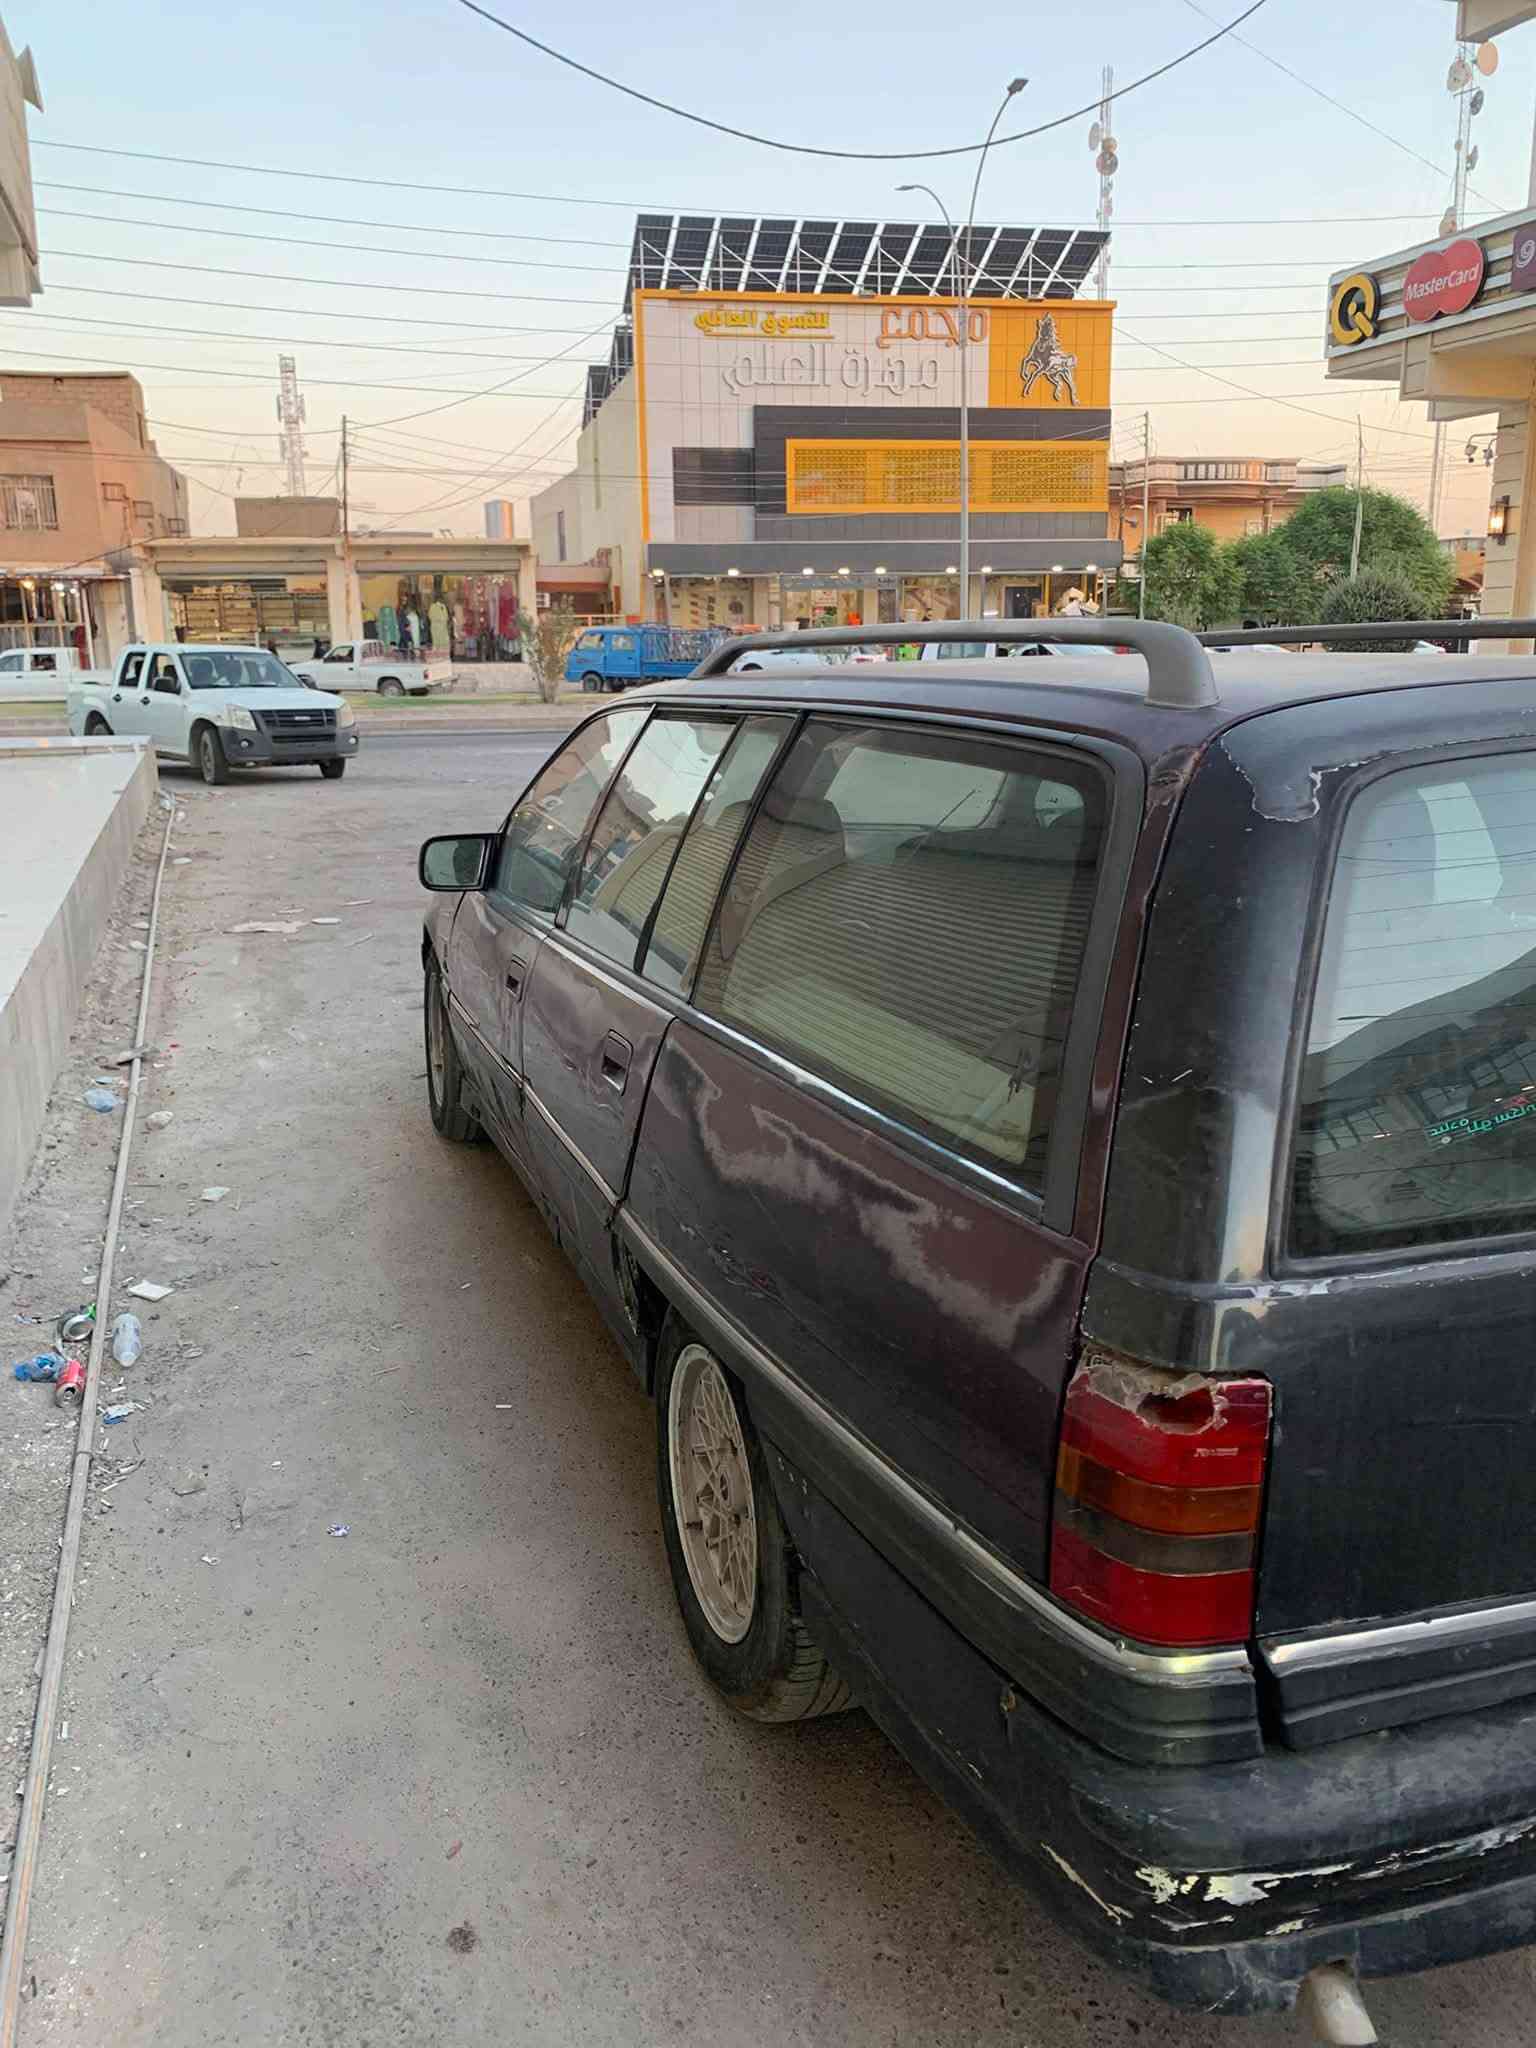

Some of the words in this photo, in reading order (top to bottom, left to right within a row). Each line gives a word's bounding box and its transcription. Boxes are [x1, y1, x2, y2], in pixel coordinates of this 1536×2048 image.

[1406, 264, 1480, 301] MasterCard
[694, 305, 757, 333] العائلي
[761, 309, 830, 335] للتسوق
[876, 305, 989, 349] مجمع
[840, 347, 942, 397] مهرة
